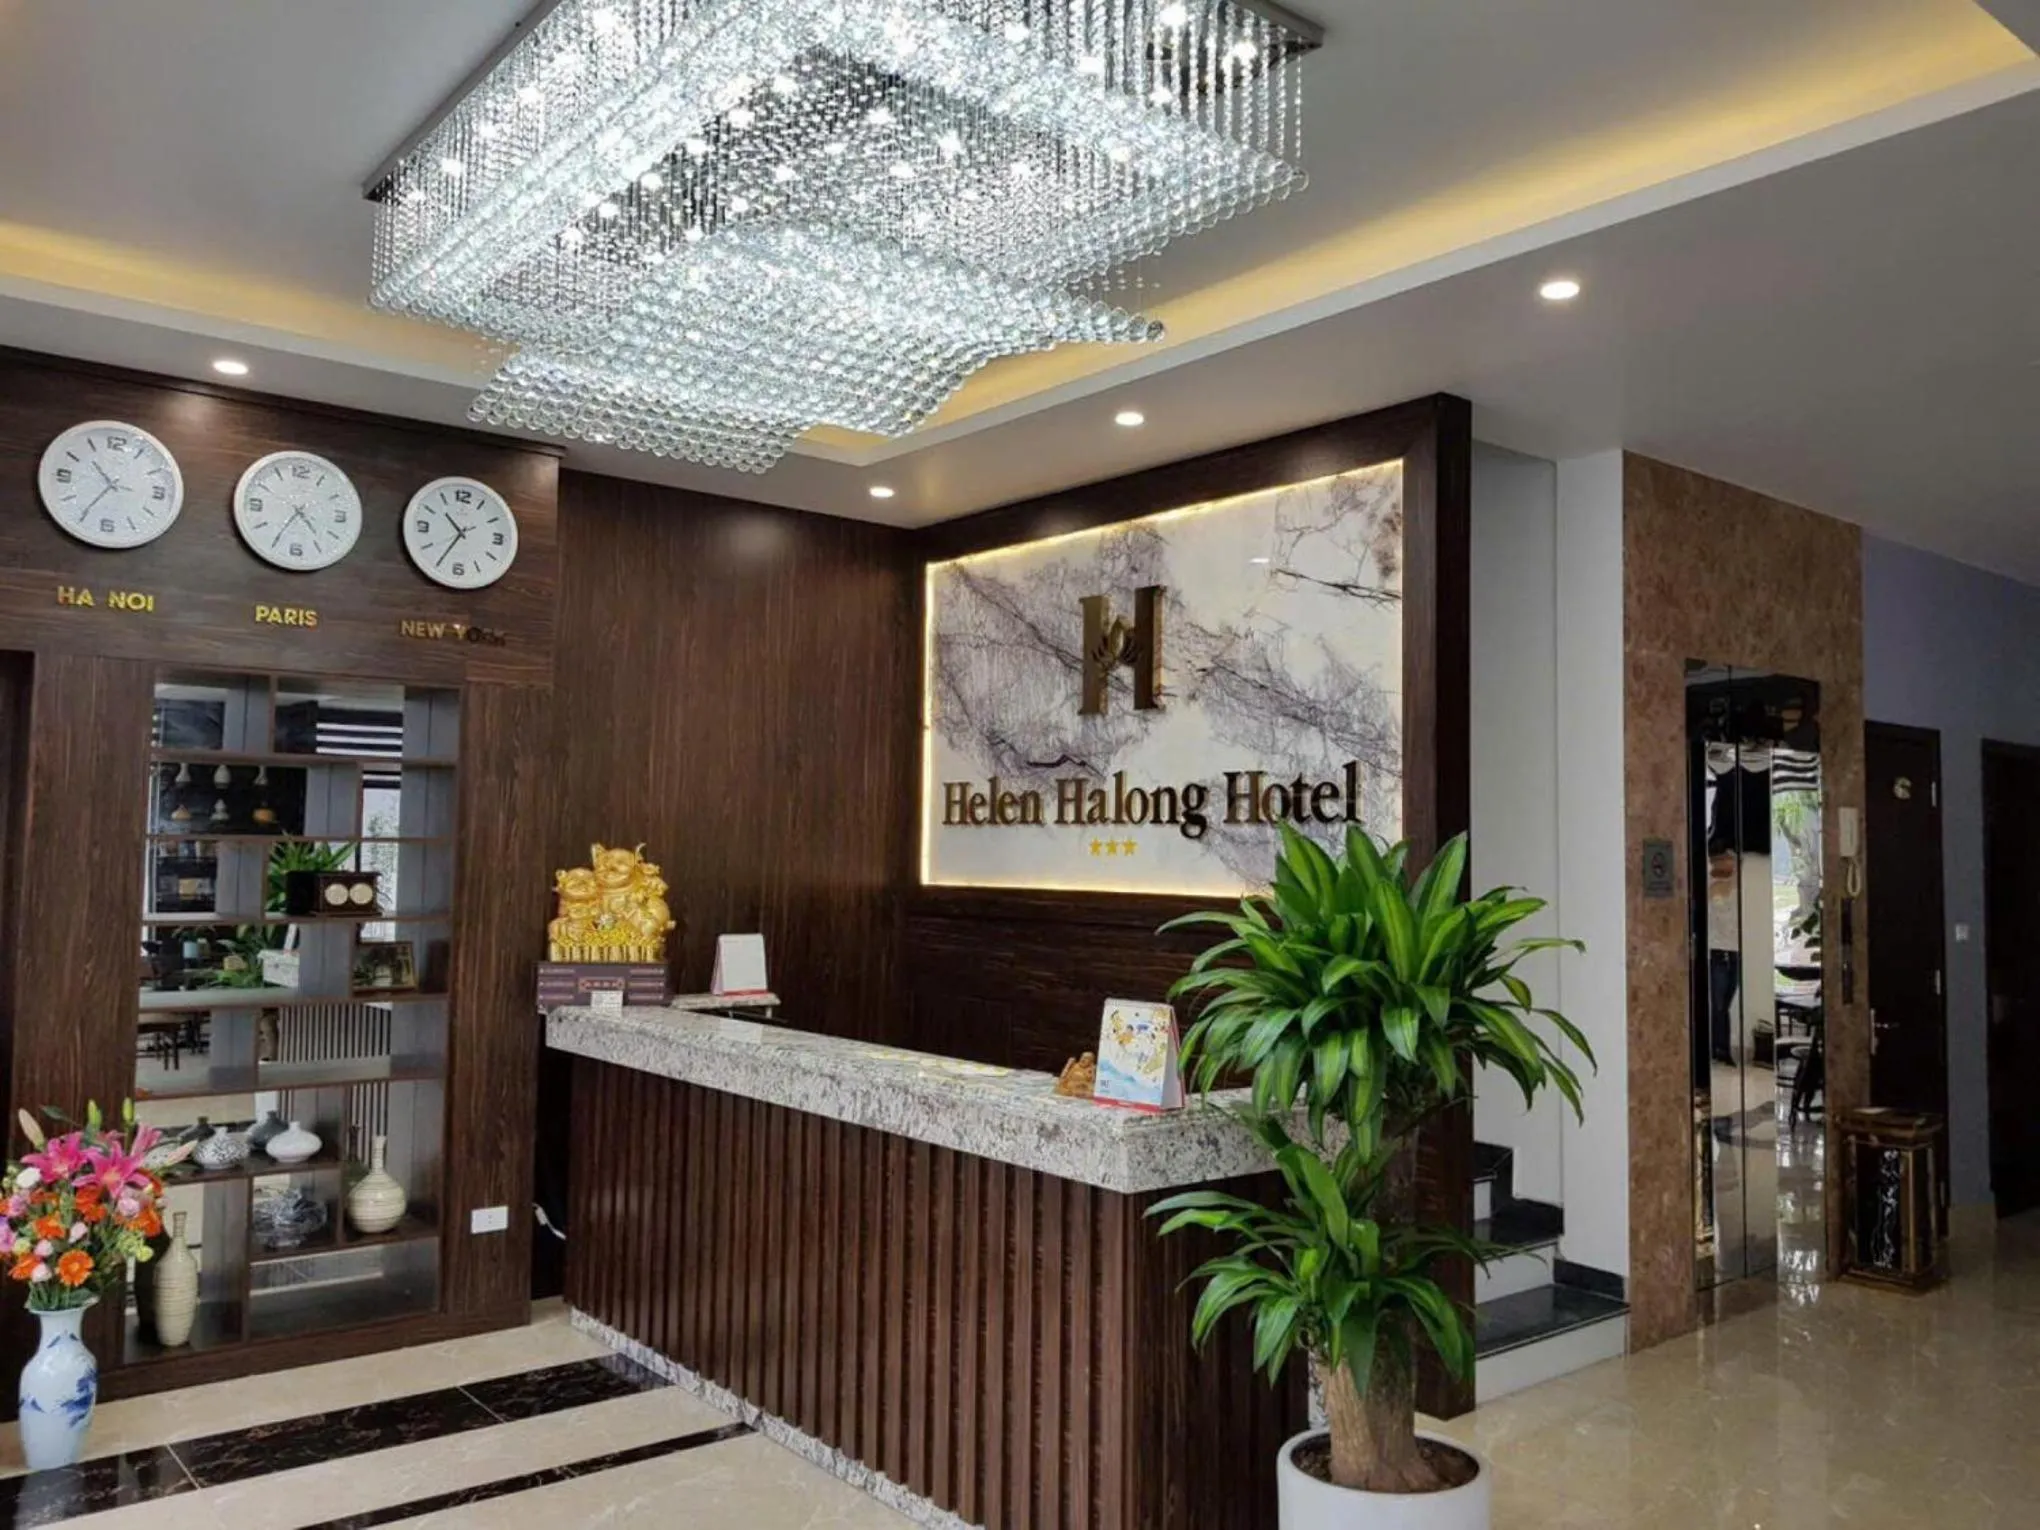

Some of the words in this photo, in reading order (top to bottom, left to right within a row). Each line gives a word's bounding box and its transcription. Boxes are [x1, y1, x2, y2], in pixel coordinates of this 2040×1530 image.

[107, 436, 127, 453] 12
[292, 466, 310, 479] 12
[152, 485, 165, 500] 3
[455, 489, 472, 504] 12
[334, 509, 346, 523] 3
[101, 518, 114, 532] 6
[493, 532, 504, 545] 3
[290, 543, 303, 556] 6
[452, 563, 464, 575] 6
[57, 586, 95, 606] HA
[108, 590, 154, 612] NOI
[255, 605, 318, 627] PARIS
[401, 620, 445, 638] NEW
[942, 776, 1044, 825] Helen
[1054, 771, 1209, 840] Halong
[1222, 760, 1364, 825] Hotel
